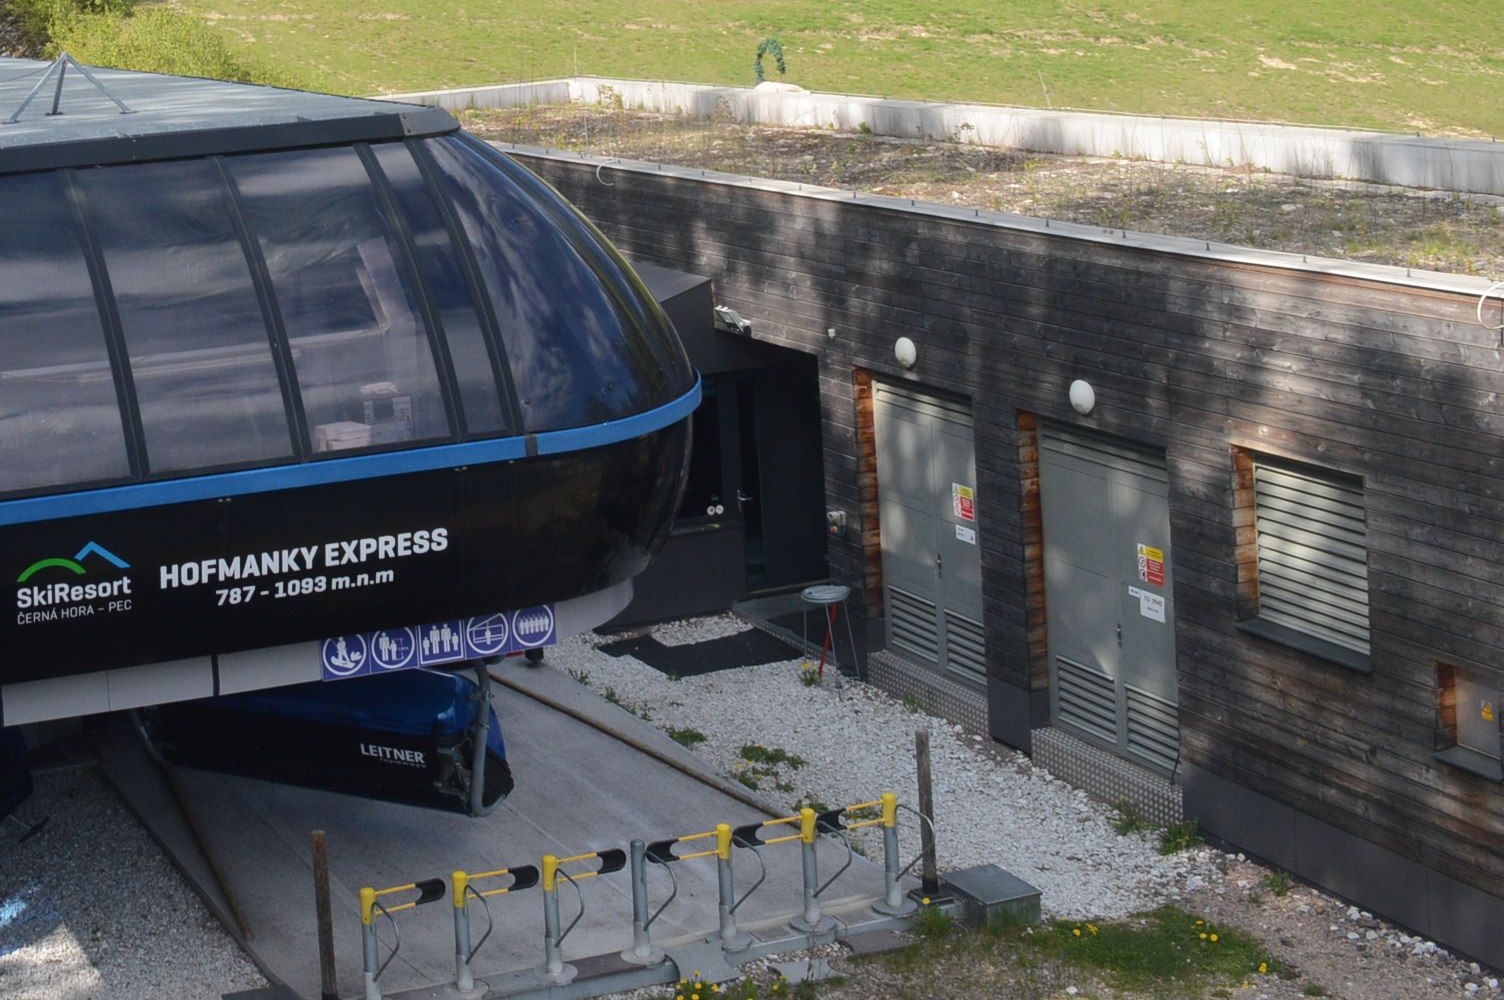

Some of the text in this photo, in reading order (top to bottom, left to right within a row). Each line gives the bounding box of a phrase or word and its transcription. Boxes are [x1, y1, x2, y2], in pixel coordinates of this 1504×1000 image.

[160, 527, 448, 589] HOFMANKY EXPRESS
[16, 576, 132, 609] SkiResort
[215, 585, 256, 606] 787
[274, 575, 326, 598] 1093
[331, 569, 394, 591] m.n.m
[17, 607, 58, 625] ČERNÁ
[61, 604, 94, 619] HORA
[108, 599, 132, 613] PEC
[360, 743, 425, 764] LEITNER
